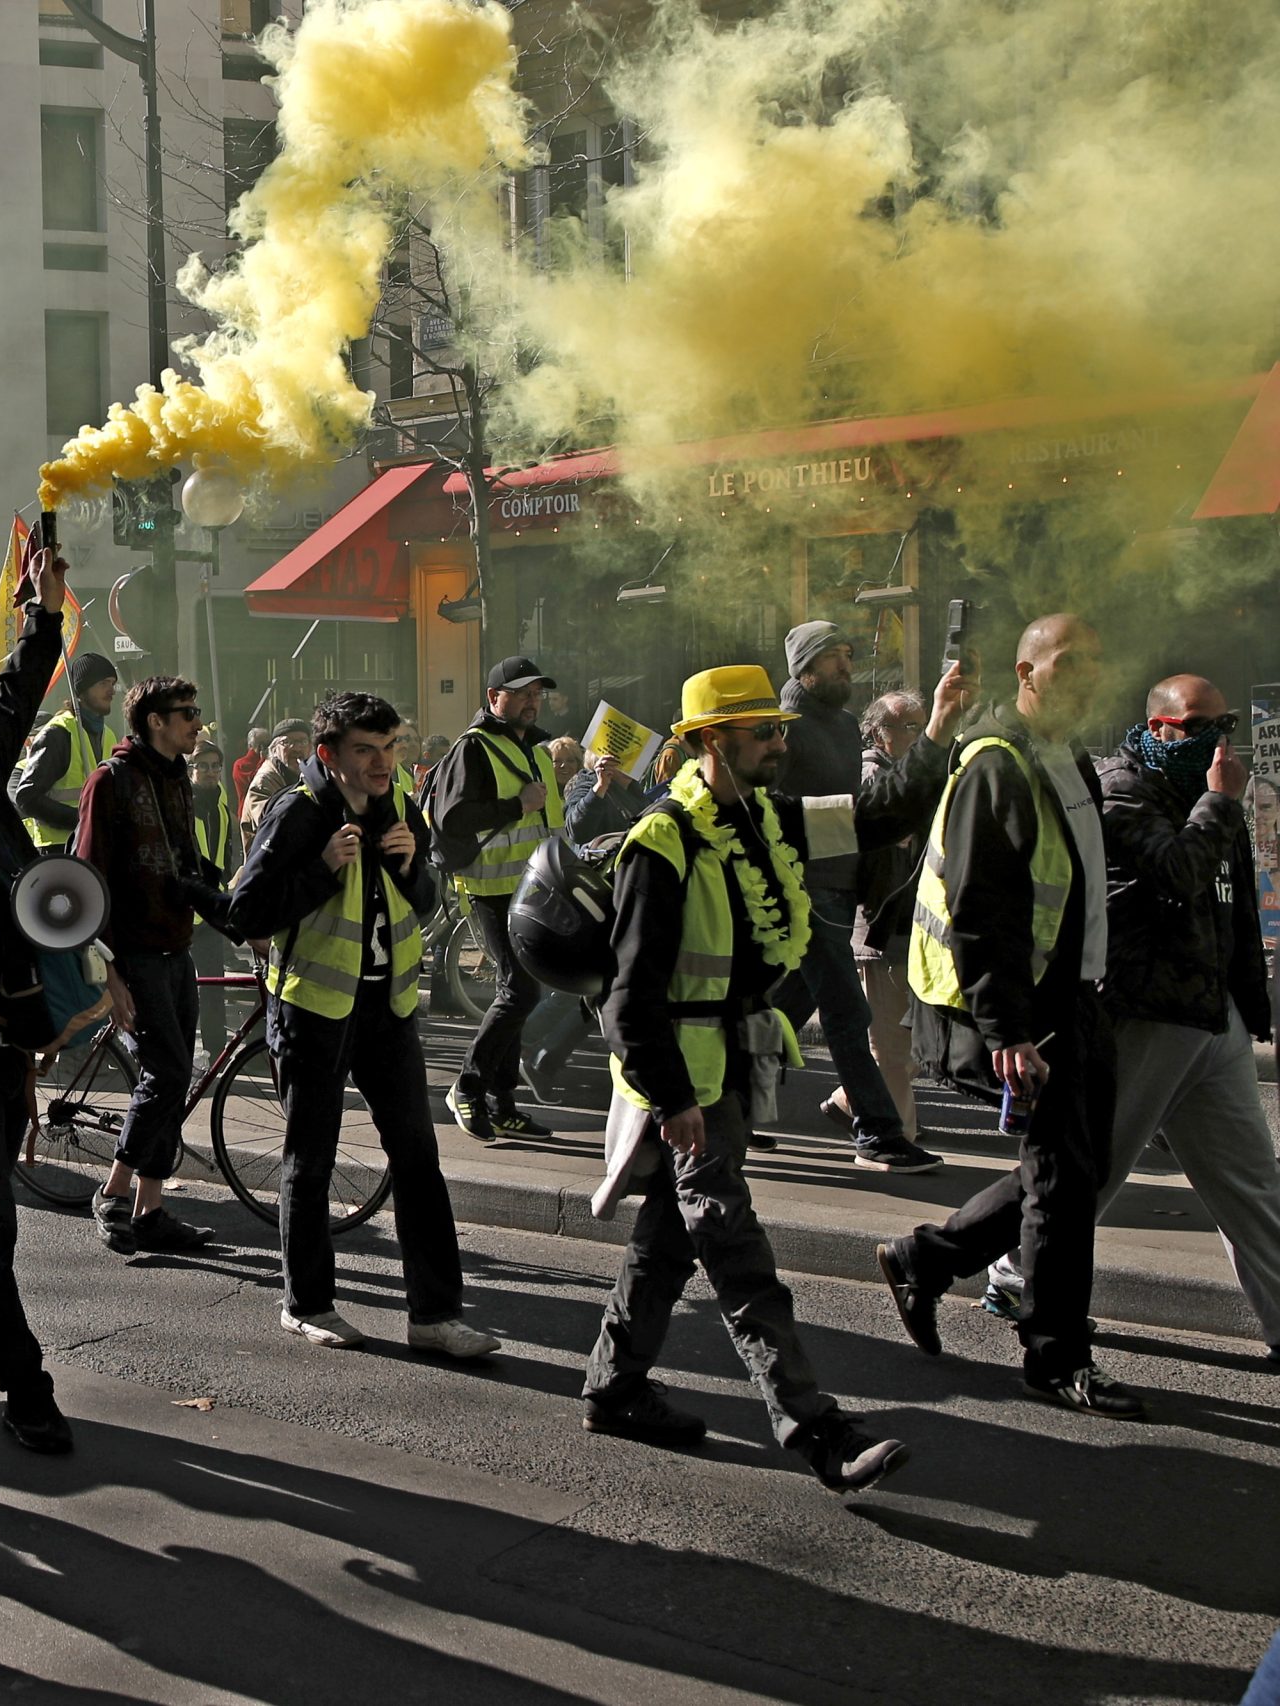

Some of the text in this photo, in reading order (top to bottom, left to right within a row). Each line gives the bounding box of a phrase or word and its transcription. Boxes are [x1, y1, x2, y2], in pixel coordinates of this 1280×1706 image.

[1009, 427, 1163, 464] RESTAURANT
[708, 457, 871, 497] LE PONTHIEU
[501, 493, 581, 518] COMPTOIR
